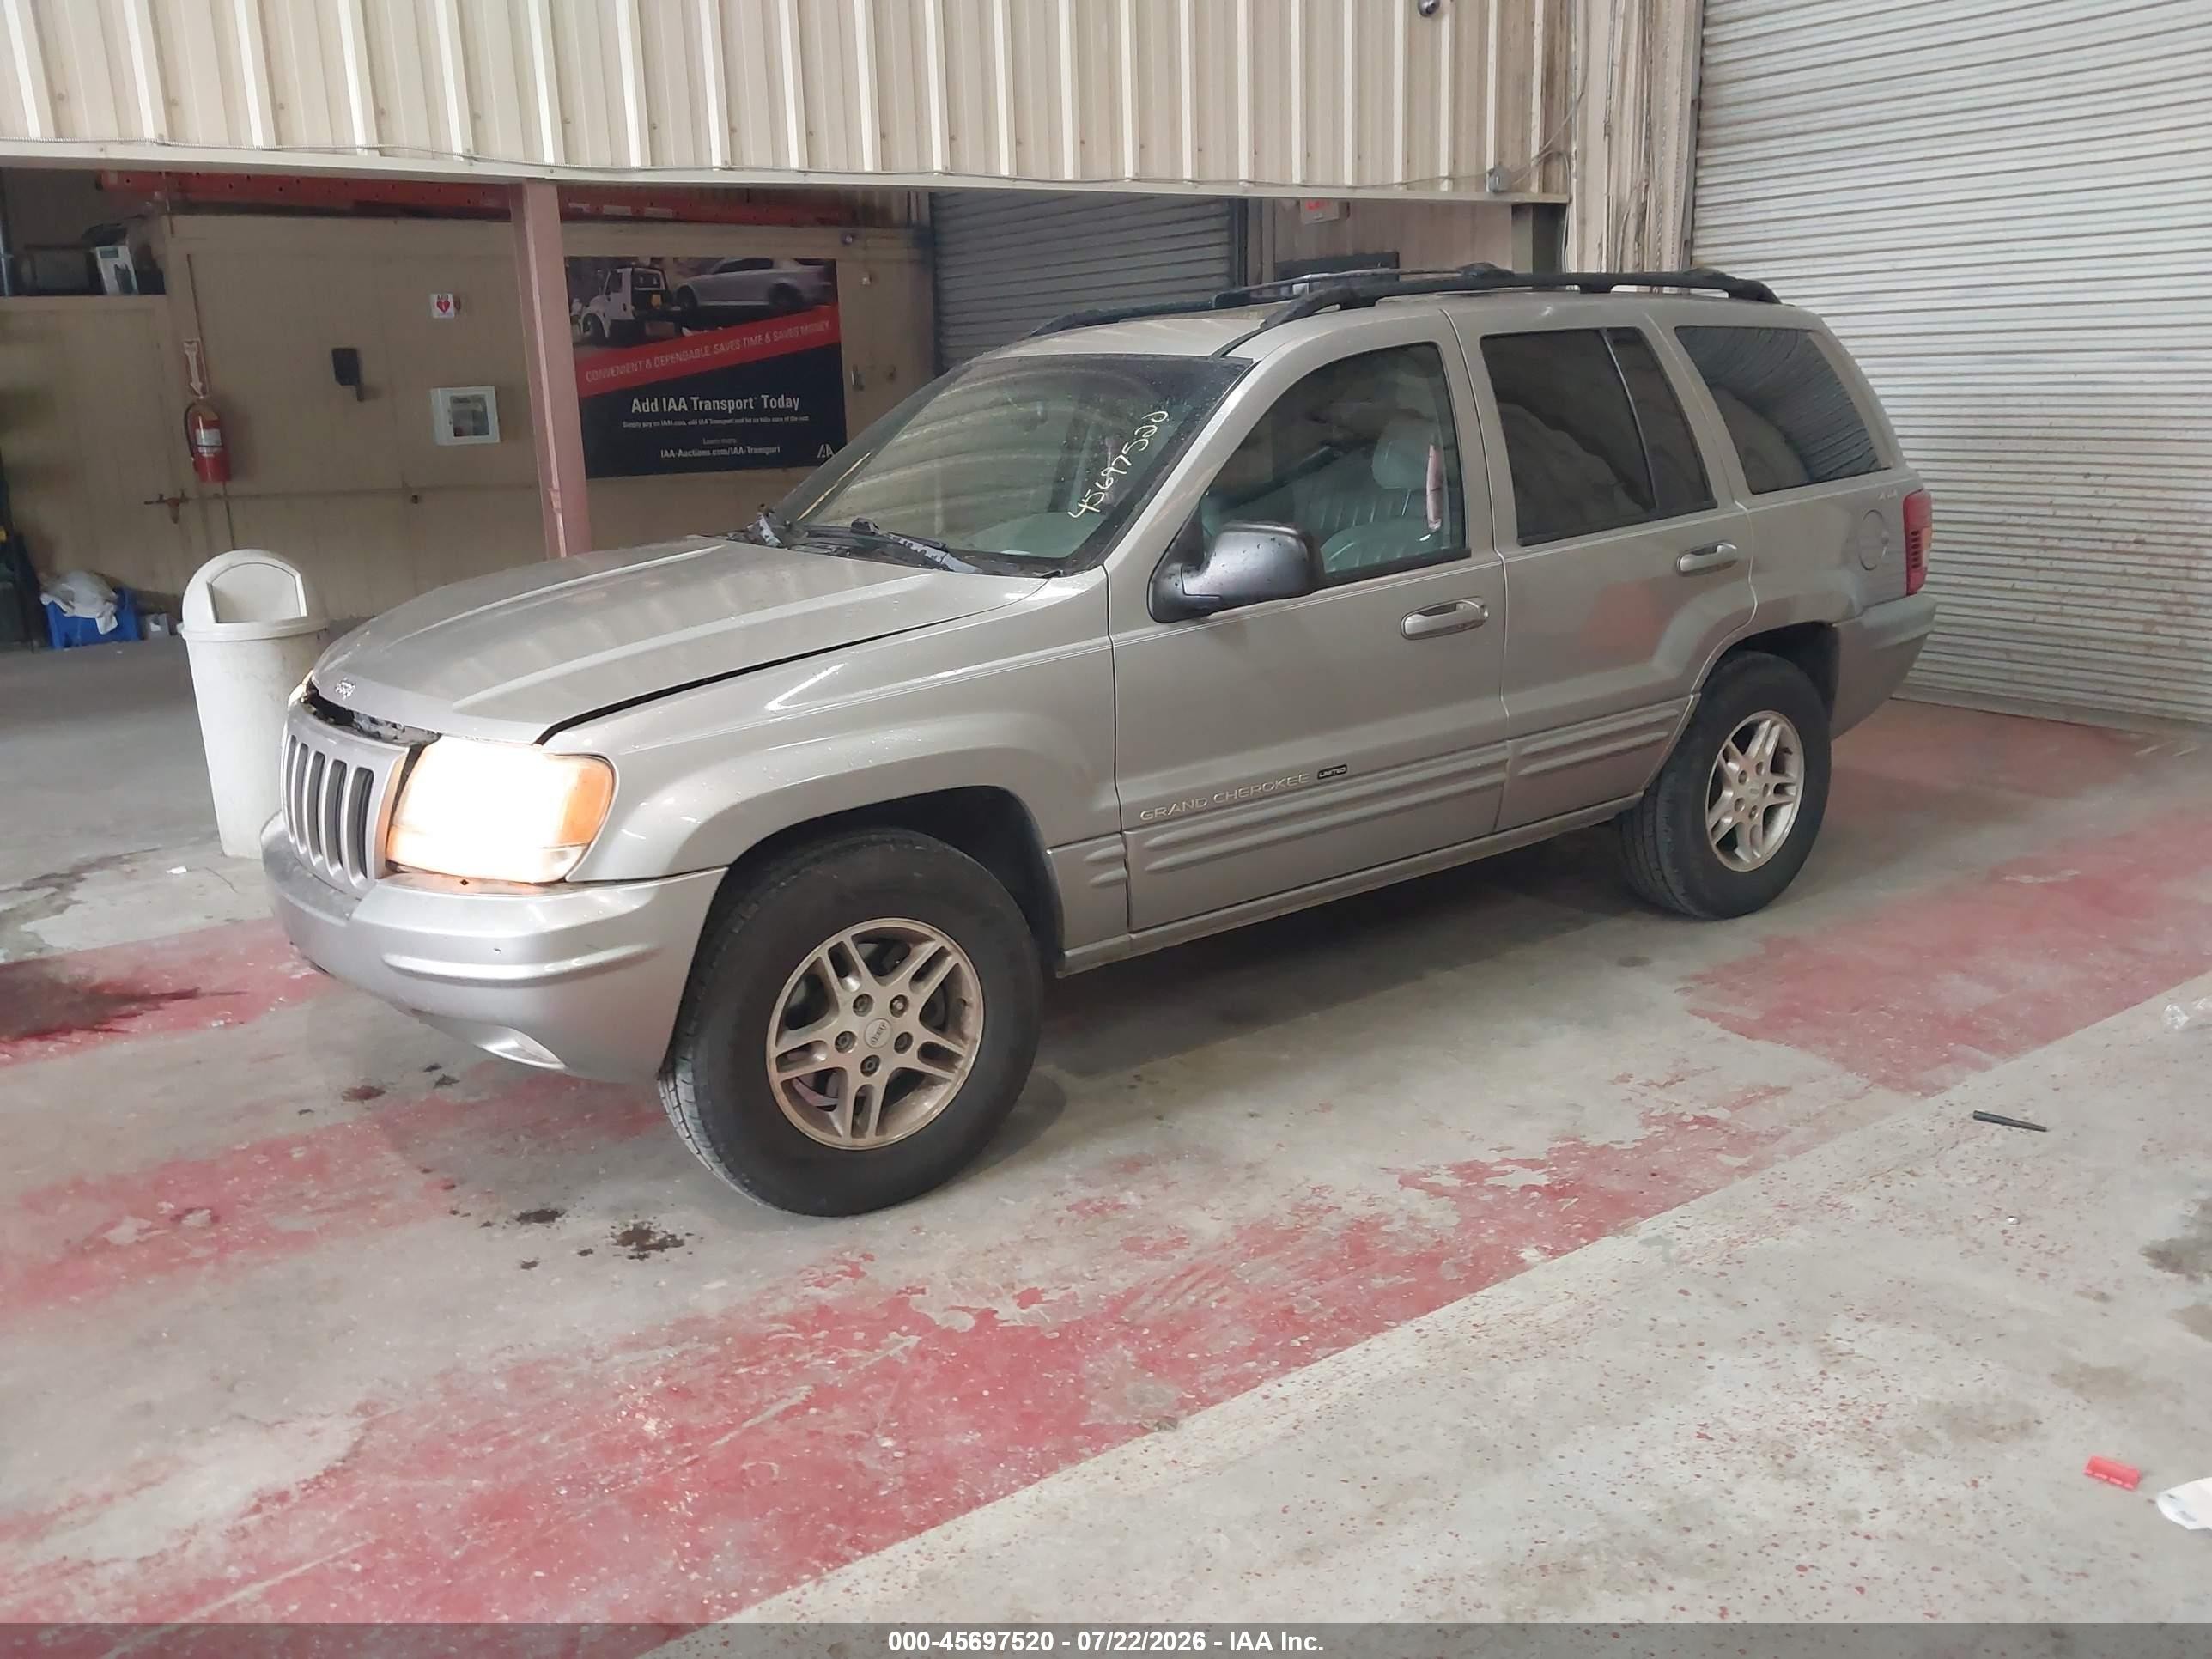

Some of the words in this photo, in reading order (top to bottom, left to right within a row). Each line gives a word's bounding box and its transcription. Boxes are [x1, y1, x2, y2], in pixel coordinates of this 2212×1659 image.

[586, 360, 645, 383] CONVENIENT
[645, 356, 653, 369] &
[714, 338, 742, 356] SAVES
[742, 334, 763, 349] TIME
[764, 332, 772, 344] &
[772, 328, 799, 343] SAVES
[631, 398, 659, 413] Add
[663, 397, 688, 412] IAA
[761, 394, 800, 412] Today
[1067, 410, 1170, 519] 45697520
[1139, 797, 1208, 822] GRAND
[1212, 773, 1310, 804] CHEROKEE
